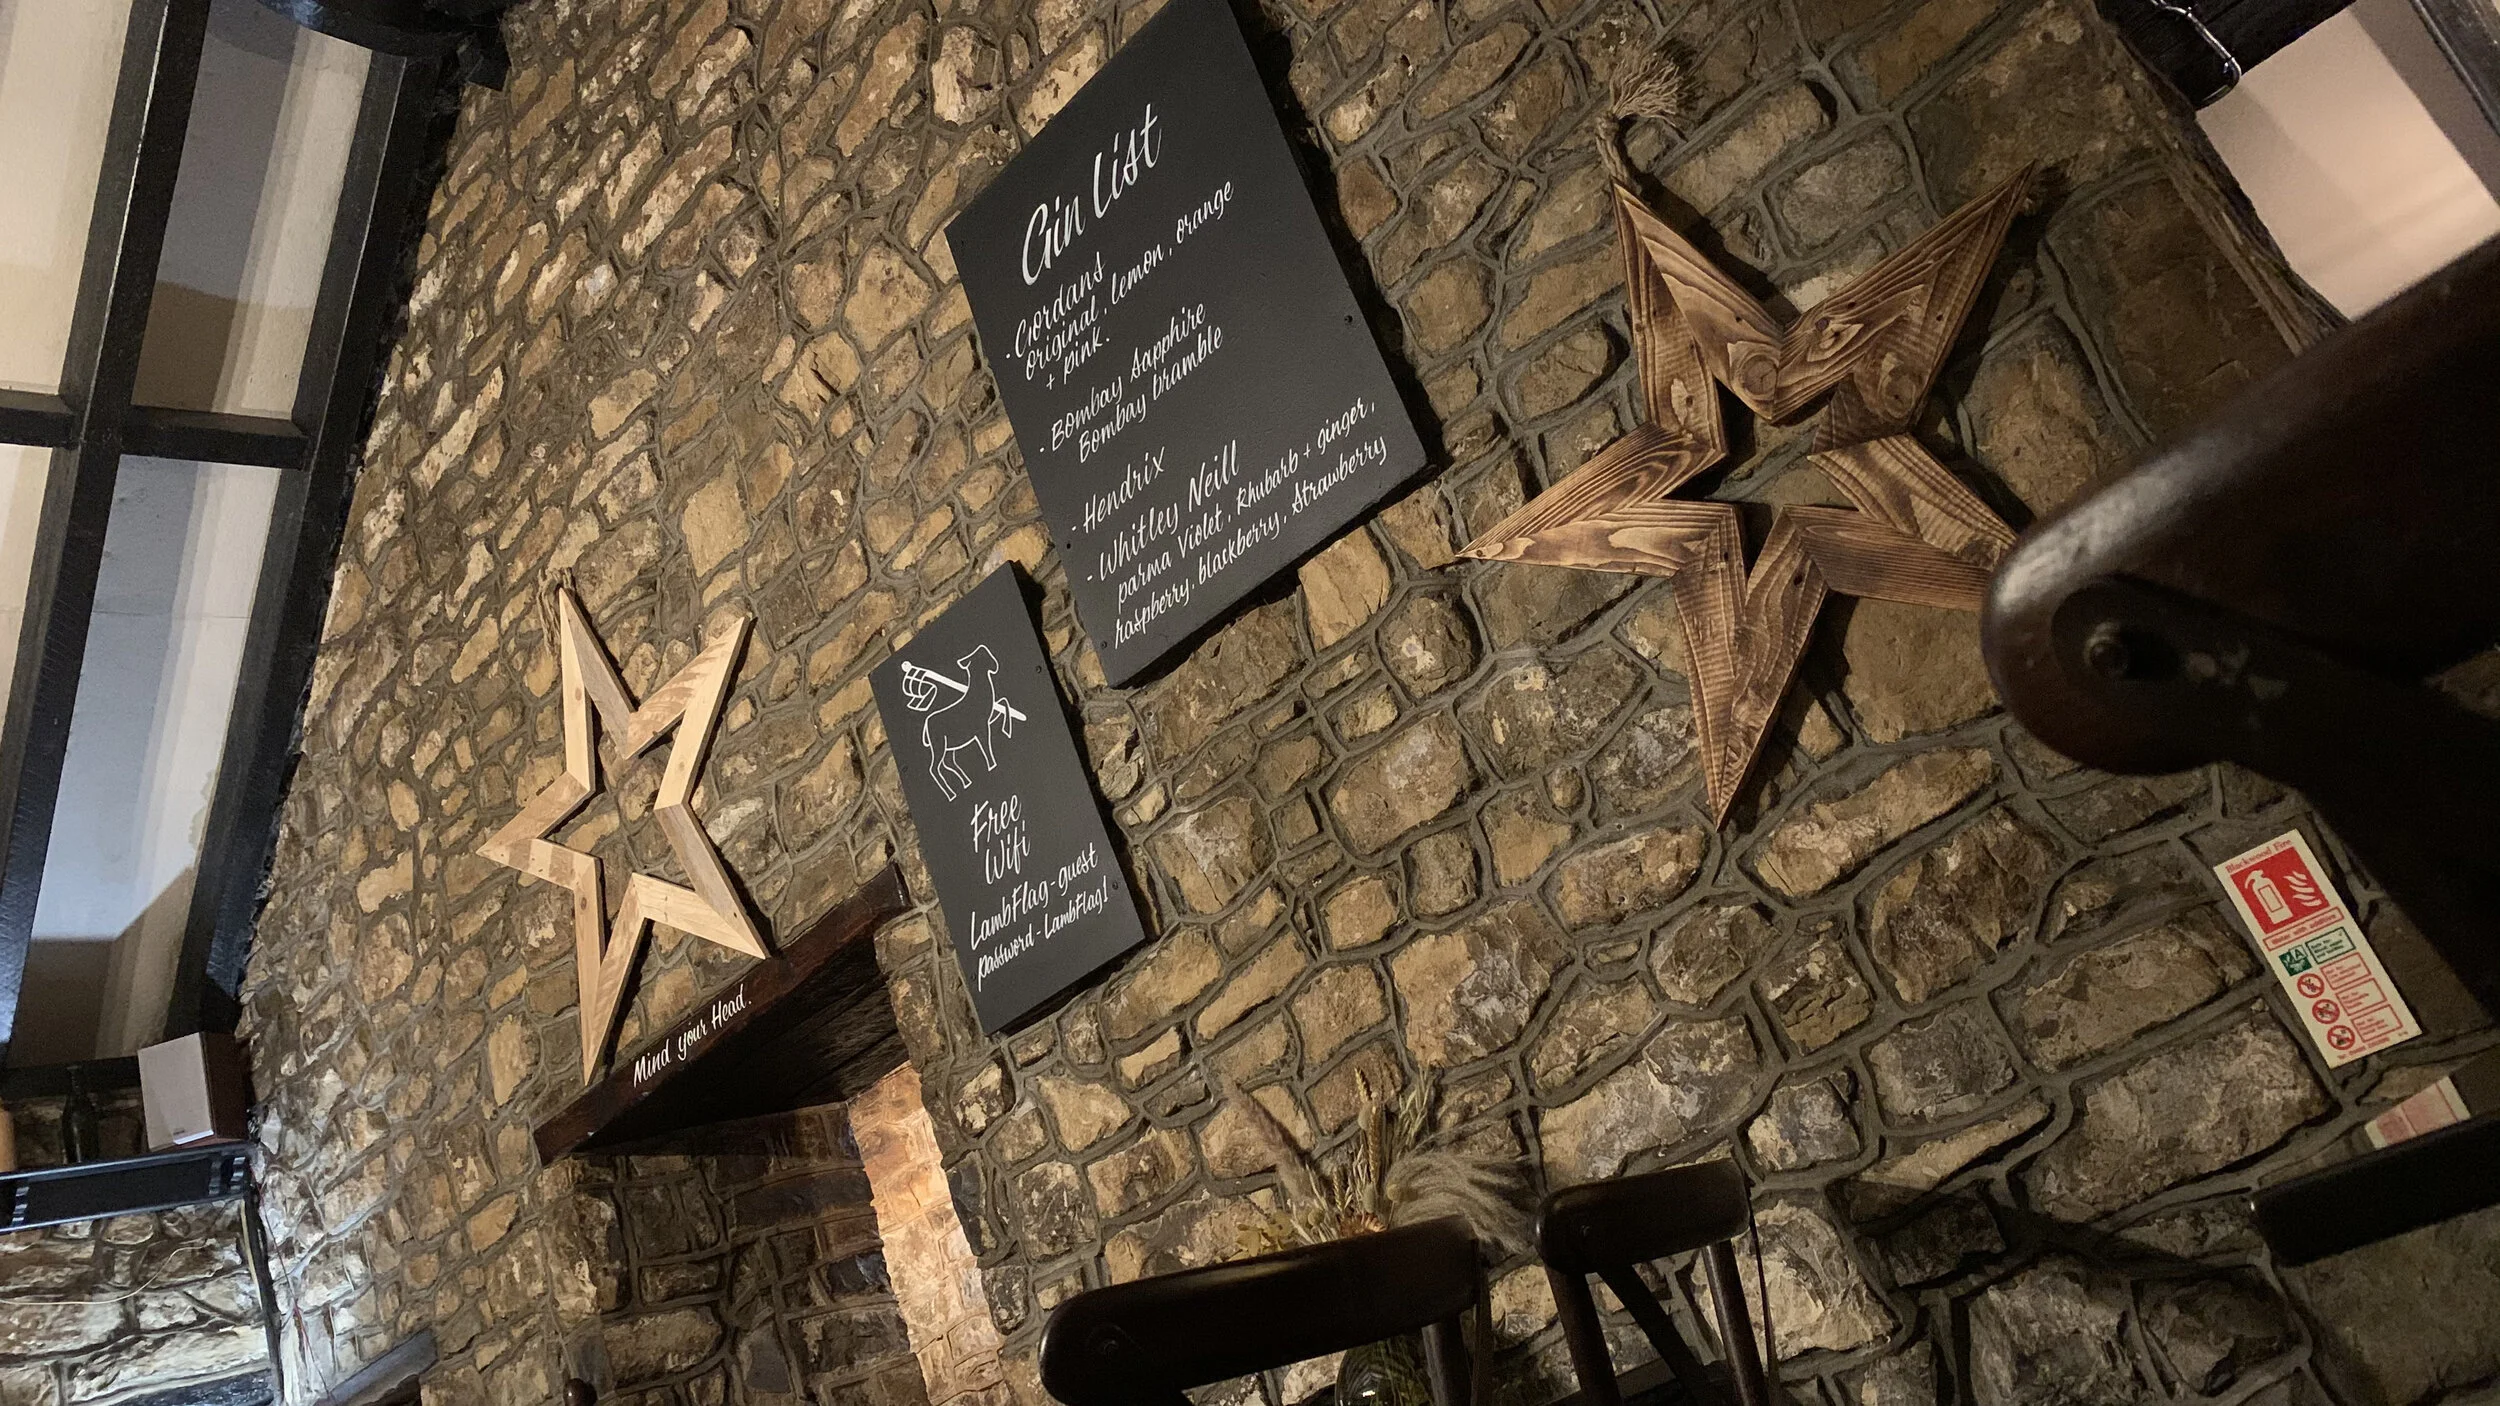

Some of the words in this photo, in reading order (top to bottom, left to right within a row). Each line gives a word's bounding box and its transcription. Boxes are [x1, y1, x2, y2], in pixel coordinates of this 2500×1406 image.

[1021, 195, 1086, 286] Gin
[1093, 103, 1162, 219] List
[1176, 180, 1234, 245] orange
[1051, 375, 1123, 452] Bombay
[1129, 303, 1206, 383] Sapphire
[1078, 393, 1147, 464] Bombay
[1152, 324, 1224, 401] bramble
[1082, 446, 1165, 534] Hendrix
[1099, 502, 1179, 582] Whitley
[1188, 439, 1240, 513] Neill
[1118, 551, 1172, 615] parma
[970, 794, 1022, 854] Free
[985, 819, 1031, 885] Wifi
[2273, 839, 2292, 851] Fire
[633, 1038, 672, 1089] Mind
[677, 1018, 708, 1062] your
